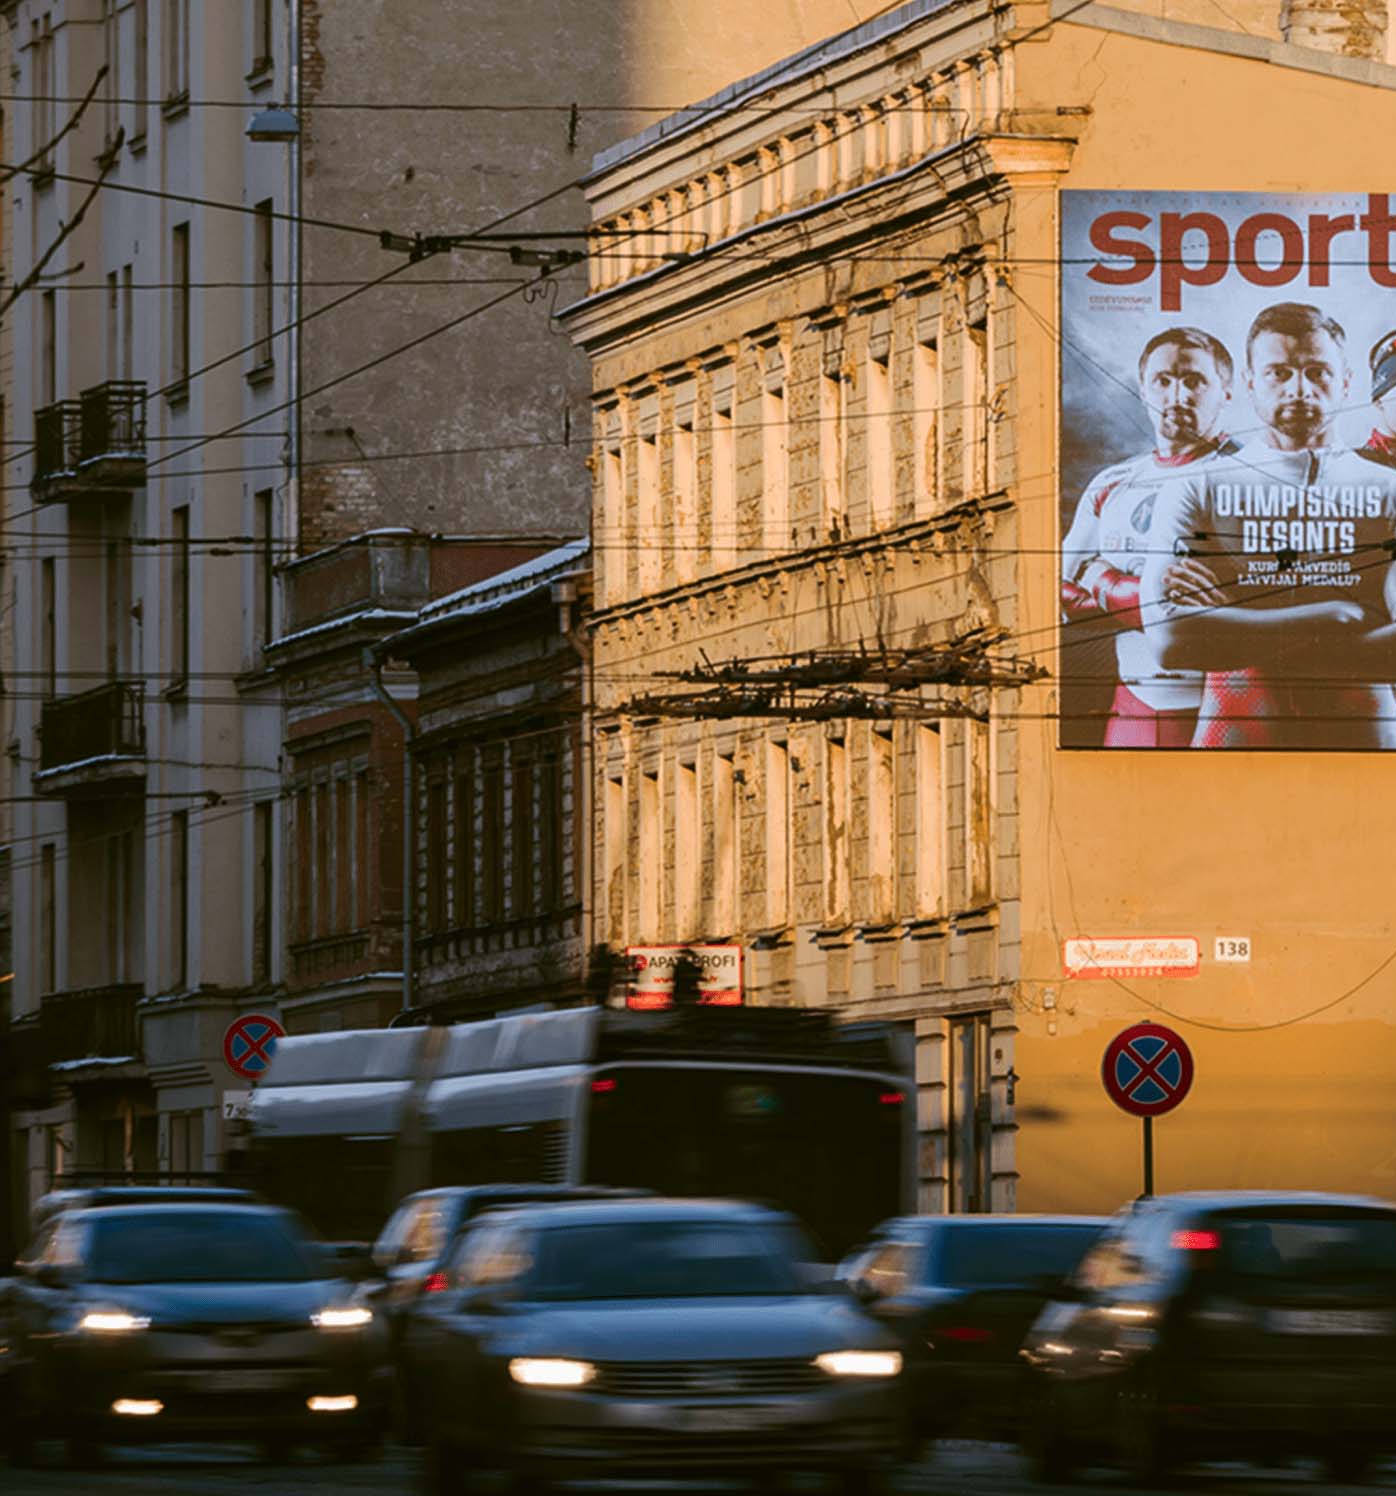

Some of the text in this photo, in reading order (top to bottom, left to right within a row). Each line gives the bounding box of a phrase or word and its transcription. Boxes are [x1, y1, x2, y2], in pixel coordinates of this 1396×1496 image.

[1215, 484, 1382, 518] OLIMPISKAIS
[1243, 520, 1356, 553] DESANTS
[1238, 573, 1298, 586] LATVIJAI
[1218, 942, 1249, 956] 138
